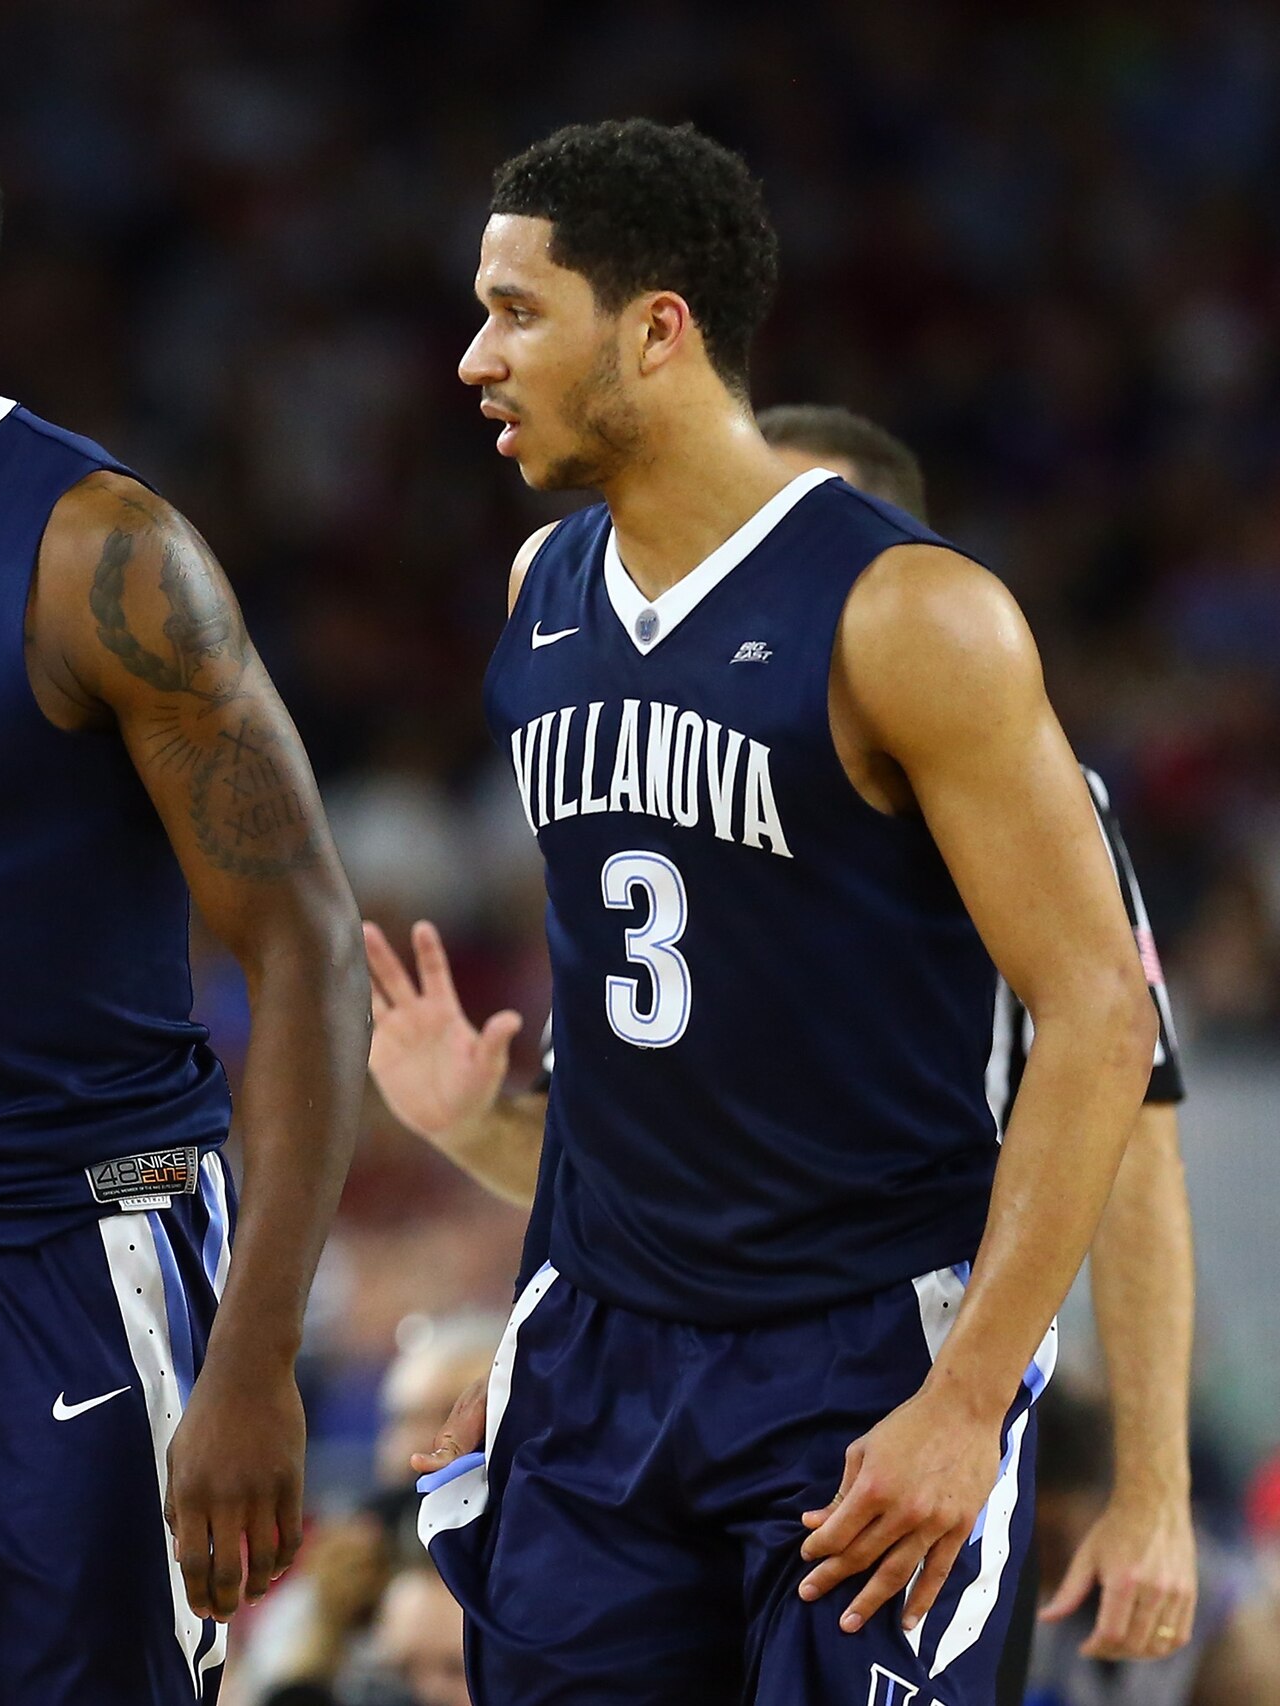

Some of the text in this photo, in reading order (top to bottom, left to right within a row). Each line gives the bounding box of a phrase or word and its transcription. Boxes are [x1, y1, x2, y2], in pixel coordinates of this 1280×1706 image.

[734, 650, 773, 660] EAST
[740, 641, 767, 650] BIG
[510, 698, 794, 859] VILLANOVA
[601, 851, 692, 1048] 3
[96, 1152, 186, 1187] 48 NIKE
[141, 1167, 187, 1183] ELITE
